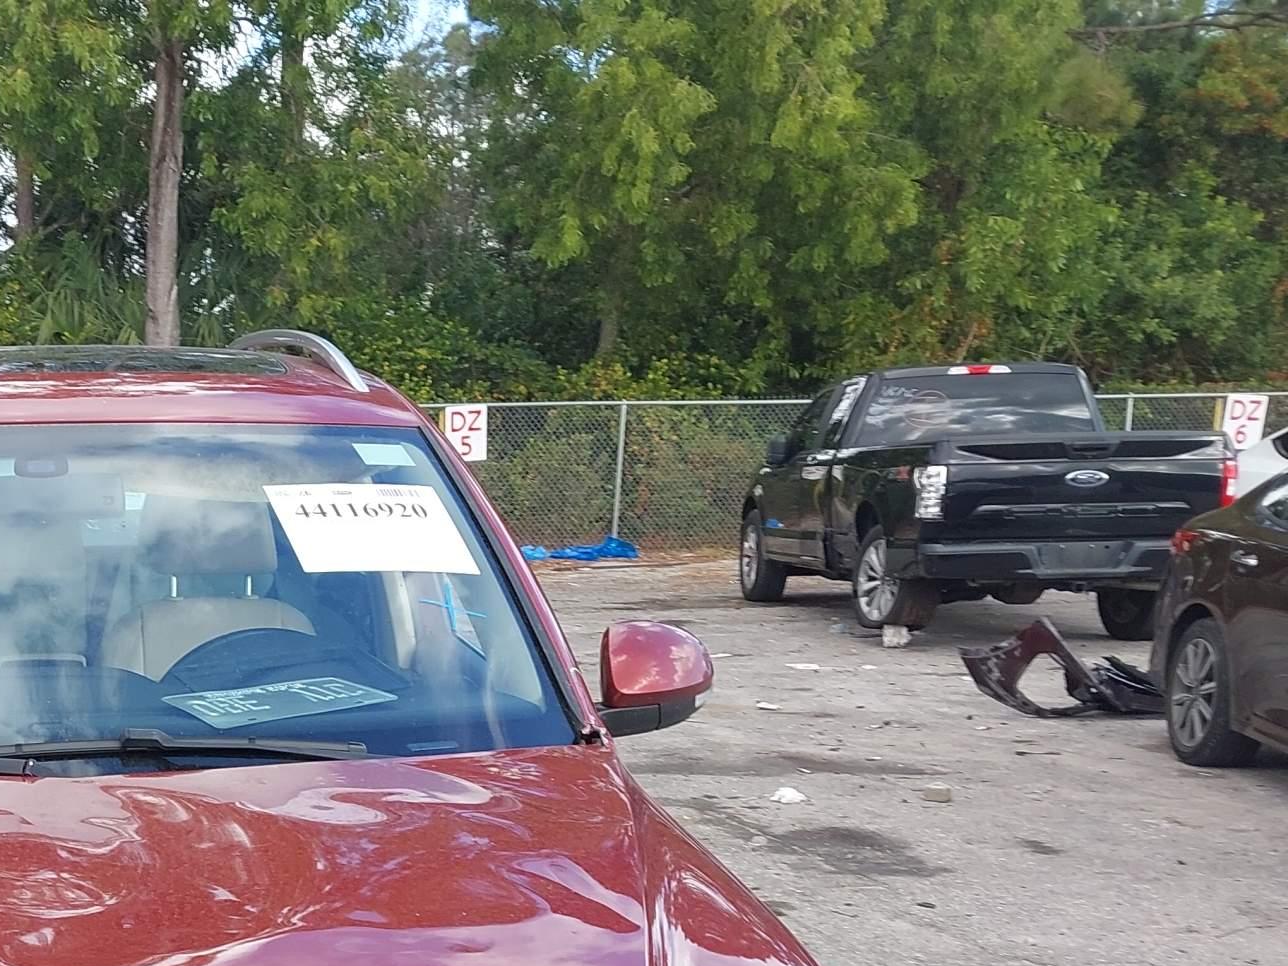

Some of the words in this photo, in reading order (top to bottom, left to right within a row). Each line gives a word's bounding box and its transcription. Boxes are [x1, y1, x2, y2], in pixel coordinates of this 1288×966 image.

[451, 410, 482, 432] DZ
[1230, 400, 1262, 421] DZ
[1235, 424, 1247, 444] 6
[461, 435, 472, 456] 5
[295, 503, 428, 518] 44116920
